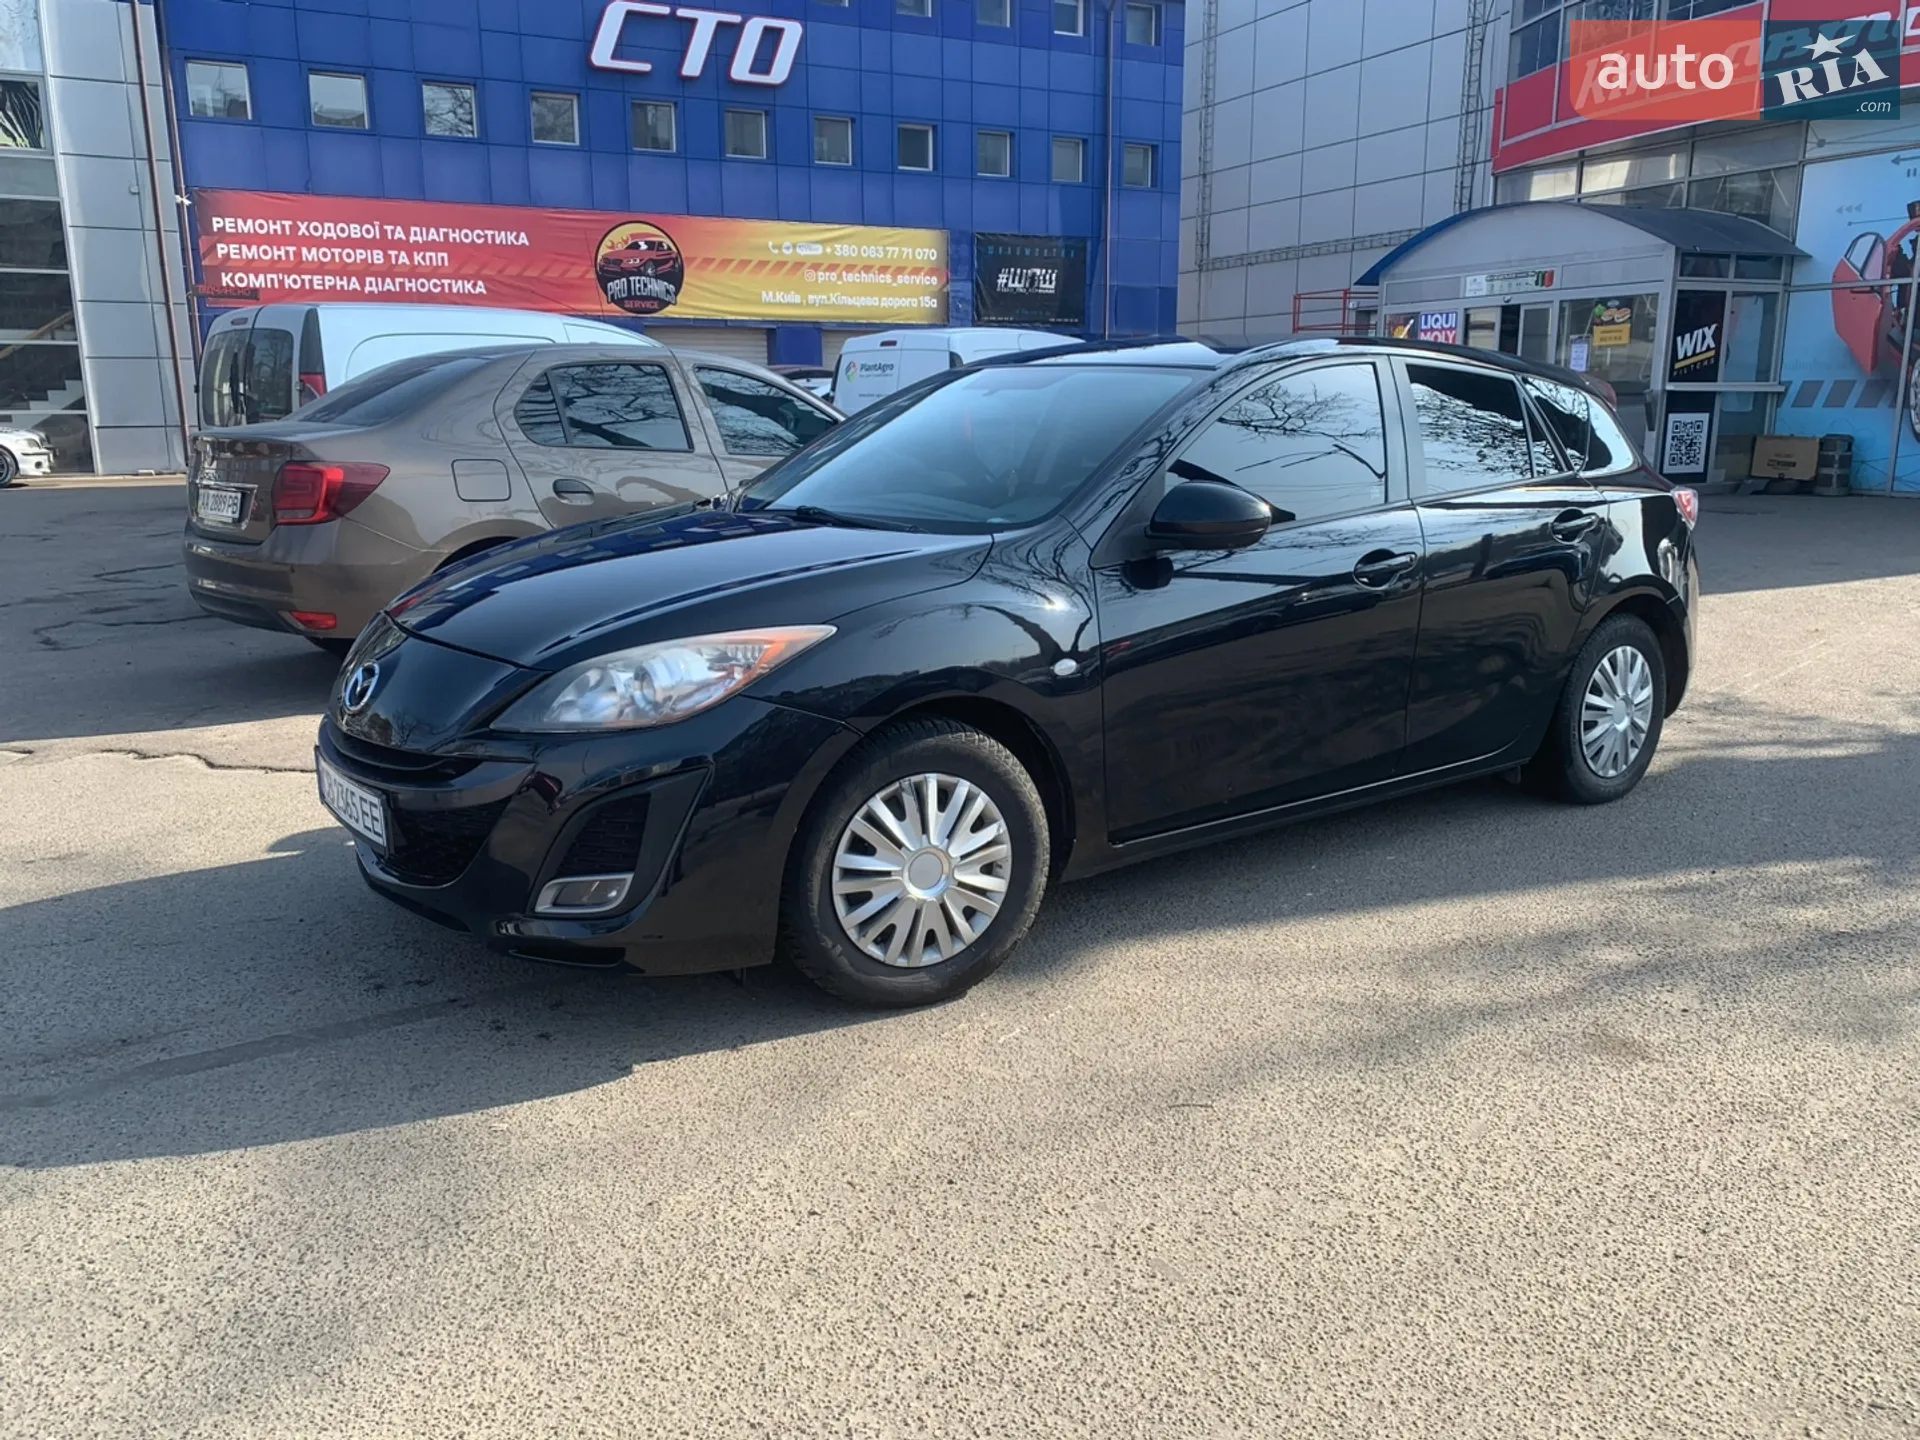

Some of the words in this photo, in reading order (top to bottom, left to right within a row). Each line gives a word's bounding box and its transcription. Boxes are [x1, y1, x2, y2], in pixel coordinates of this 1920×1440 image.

[590, 0, 804, 86] СТО
[212, 217, 293, 235] РЕМОНТ
[297, 221, 380, 240] ХОДОВОЇ
[384, 225, 406, 240] ТА
[409, 226, 530, 246] ДІАГНОСТИКА
[216, 243, 297, 262] РЕМОНТ
[301, 246, 384, 265] МОТОРІВ
[388, 250, 410, 265] ТА
[413, 251, 449, 267] КПП
[861, 246, 884, 258] 063
[886, 247, 899, 259] 77
[902, 248, 913, 260] 71
[915, 248, 937, 261] 070
[221, 272, 361, 291] КОМП'ЮТЕРНА
[364, 277, 487, 295] ДІАГНОСТИКА
[607, 278, 627, 302] PRO
[629, 276, 676, 304] TECHNICS
[818, 270, 937, 287] pro_technics_service
[623, 300, 659, 309] SERVICE
[1421, 313, 1456, 329] LIQUI
[1676, 324, 1718, 360] WIX
[860, 362, 894, 373] PlantAgro
